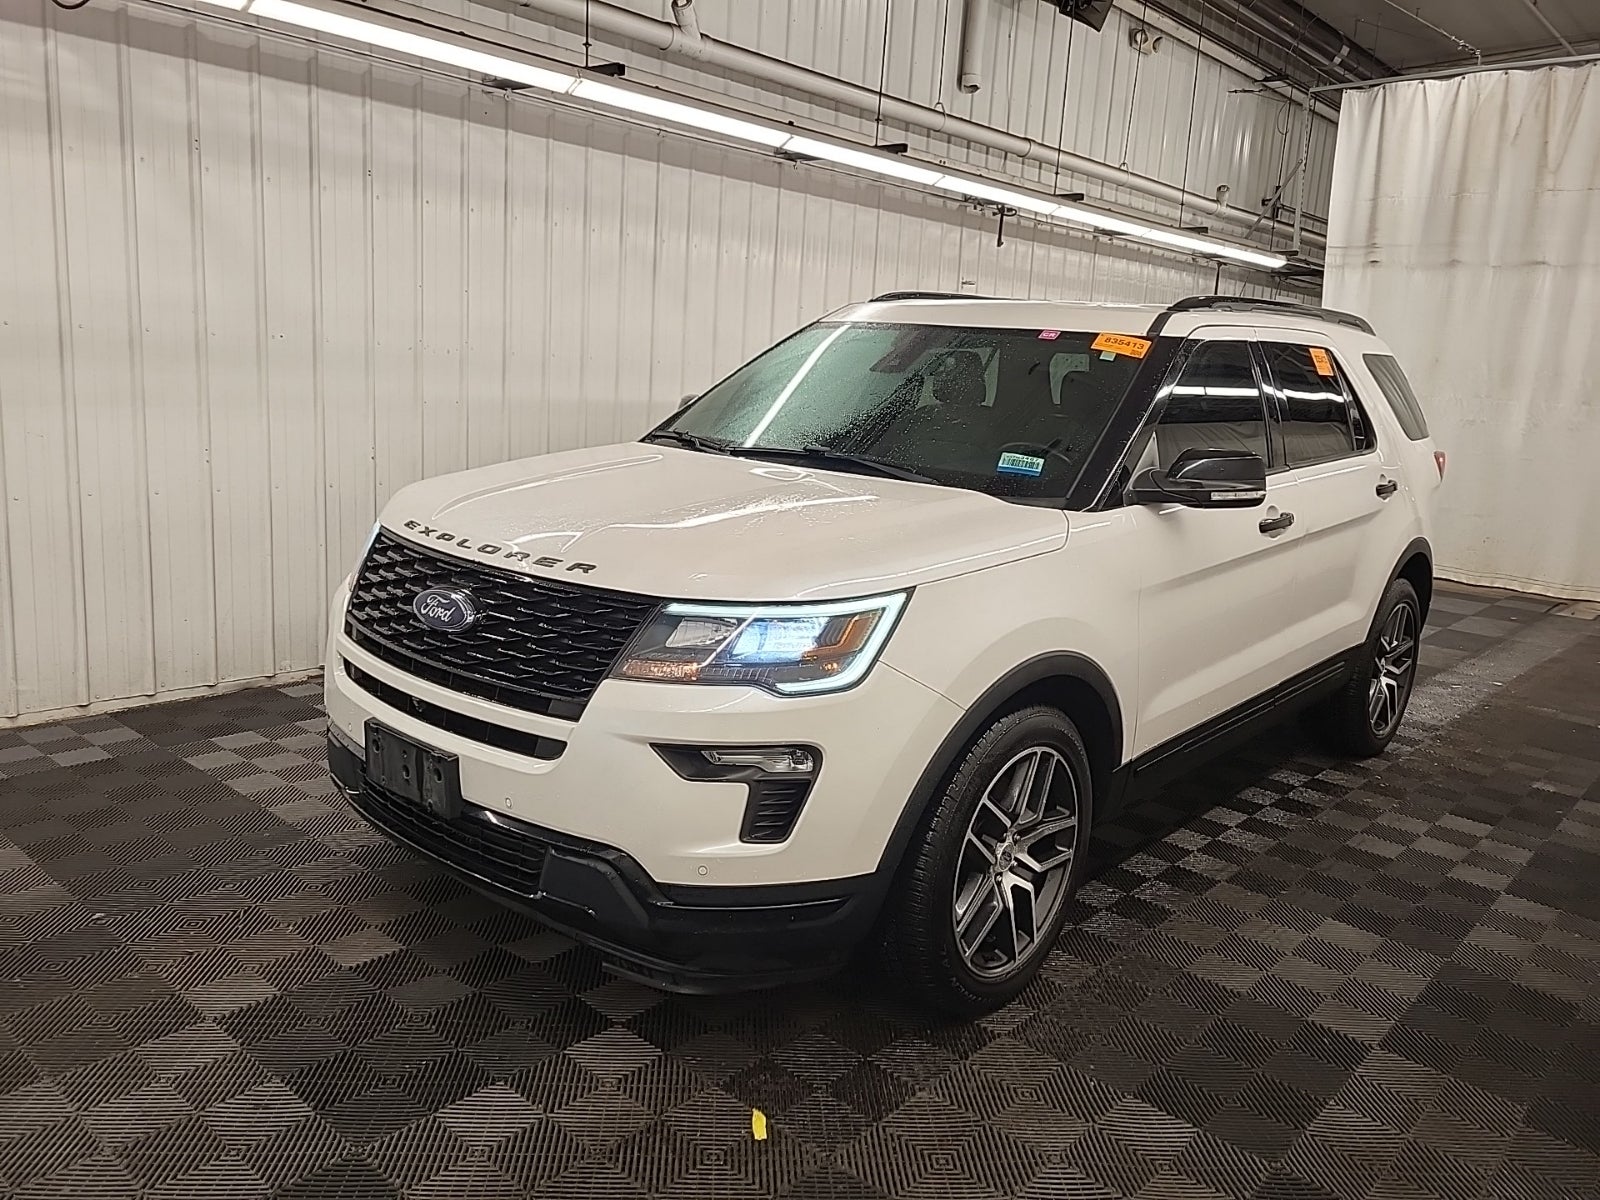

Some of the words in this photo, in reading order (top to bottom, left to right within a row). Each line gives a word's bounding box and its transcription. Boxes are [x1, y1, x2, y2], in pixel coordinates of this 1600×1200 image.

[1104, 336, 1145, 350] 835413
[403, 519, 598, 574] EXPLORER
[420, 594, 457, 623] Ford
